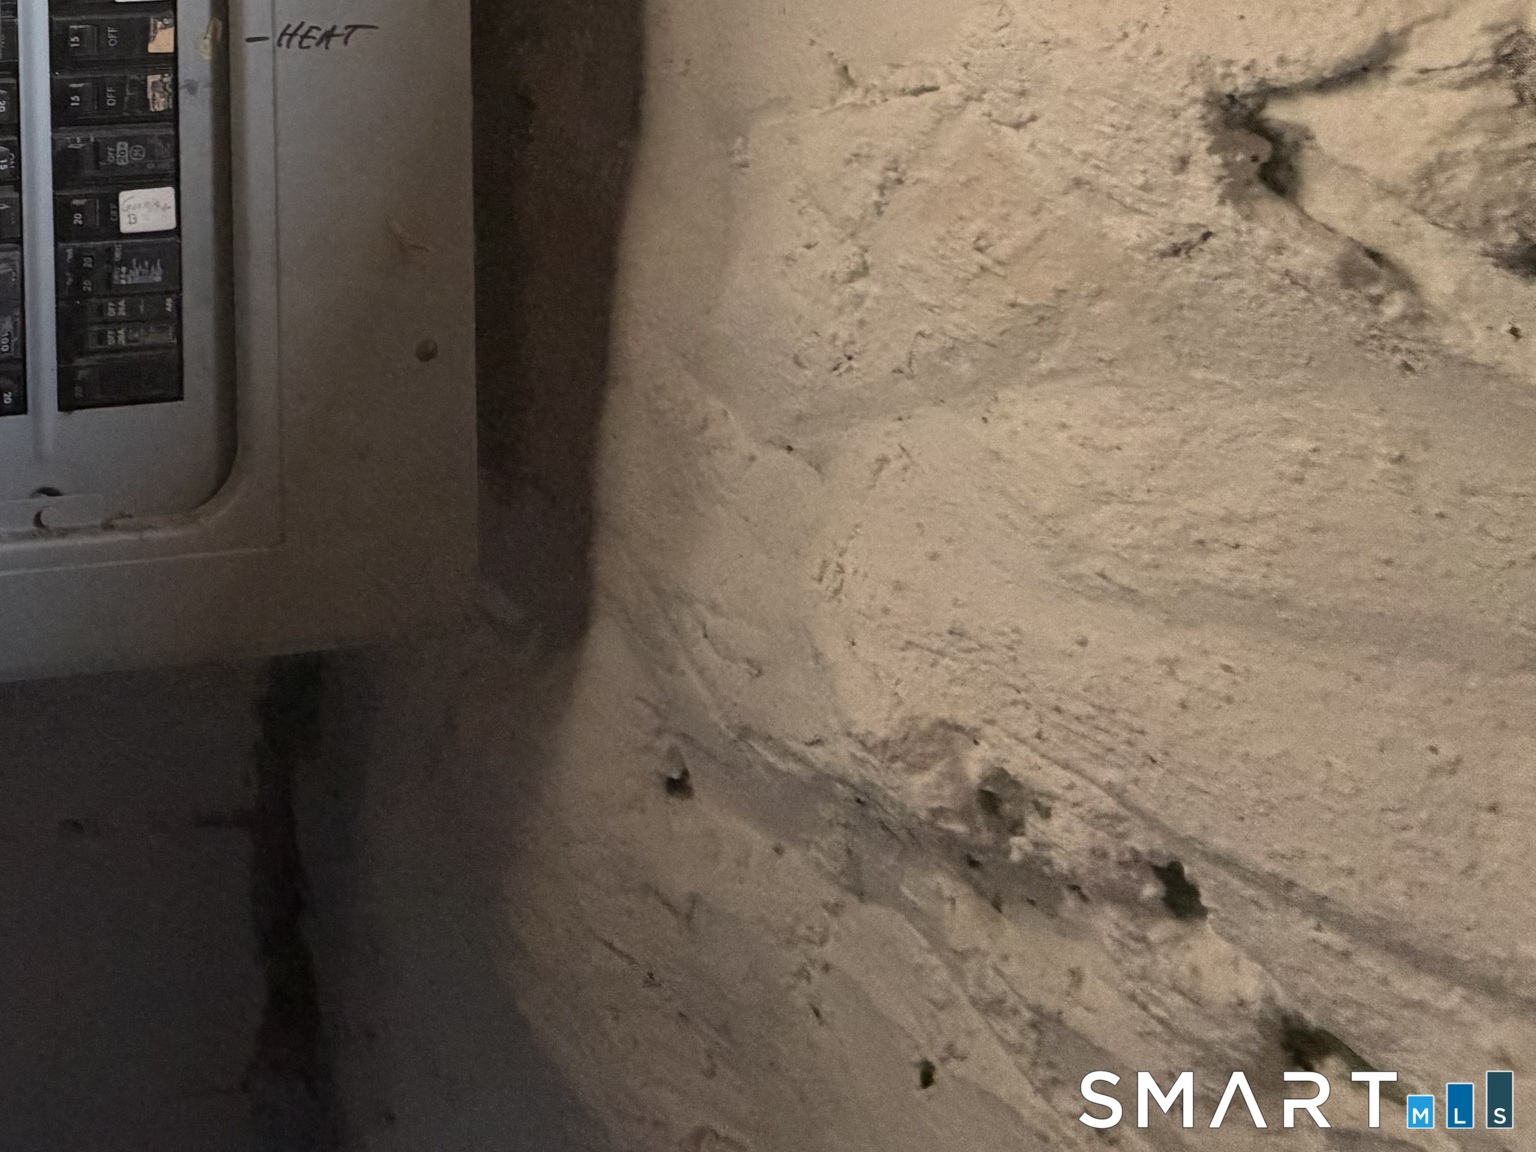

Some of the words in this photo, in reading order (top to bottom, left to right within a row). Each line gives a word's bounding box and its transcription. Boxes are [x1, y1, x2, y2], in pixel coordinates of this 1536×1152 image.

[108, 26, 118, 46] OFF
[277, 21, 380, 50] HEAT
[70, 36, 80, 48] 15
[70, 95, 80, 106] 15
[106, 86, 116, 106] OFF
[108, 147, 116, 162] OFF
[0, 159, 8, 170] 15
[73, 213, 82, 225] 20
[82, 280, 92, 292] 20
[0, 332, 12, 352] 100
[2, 392, 12, 404] 20
